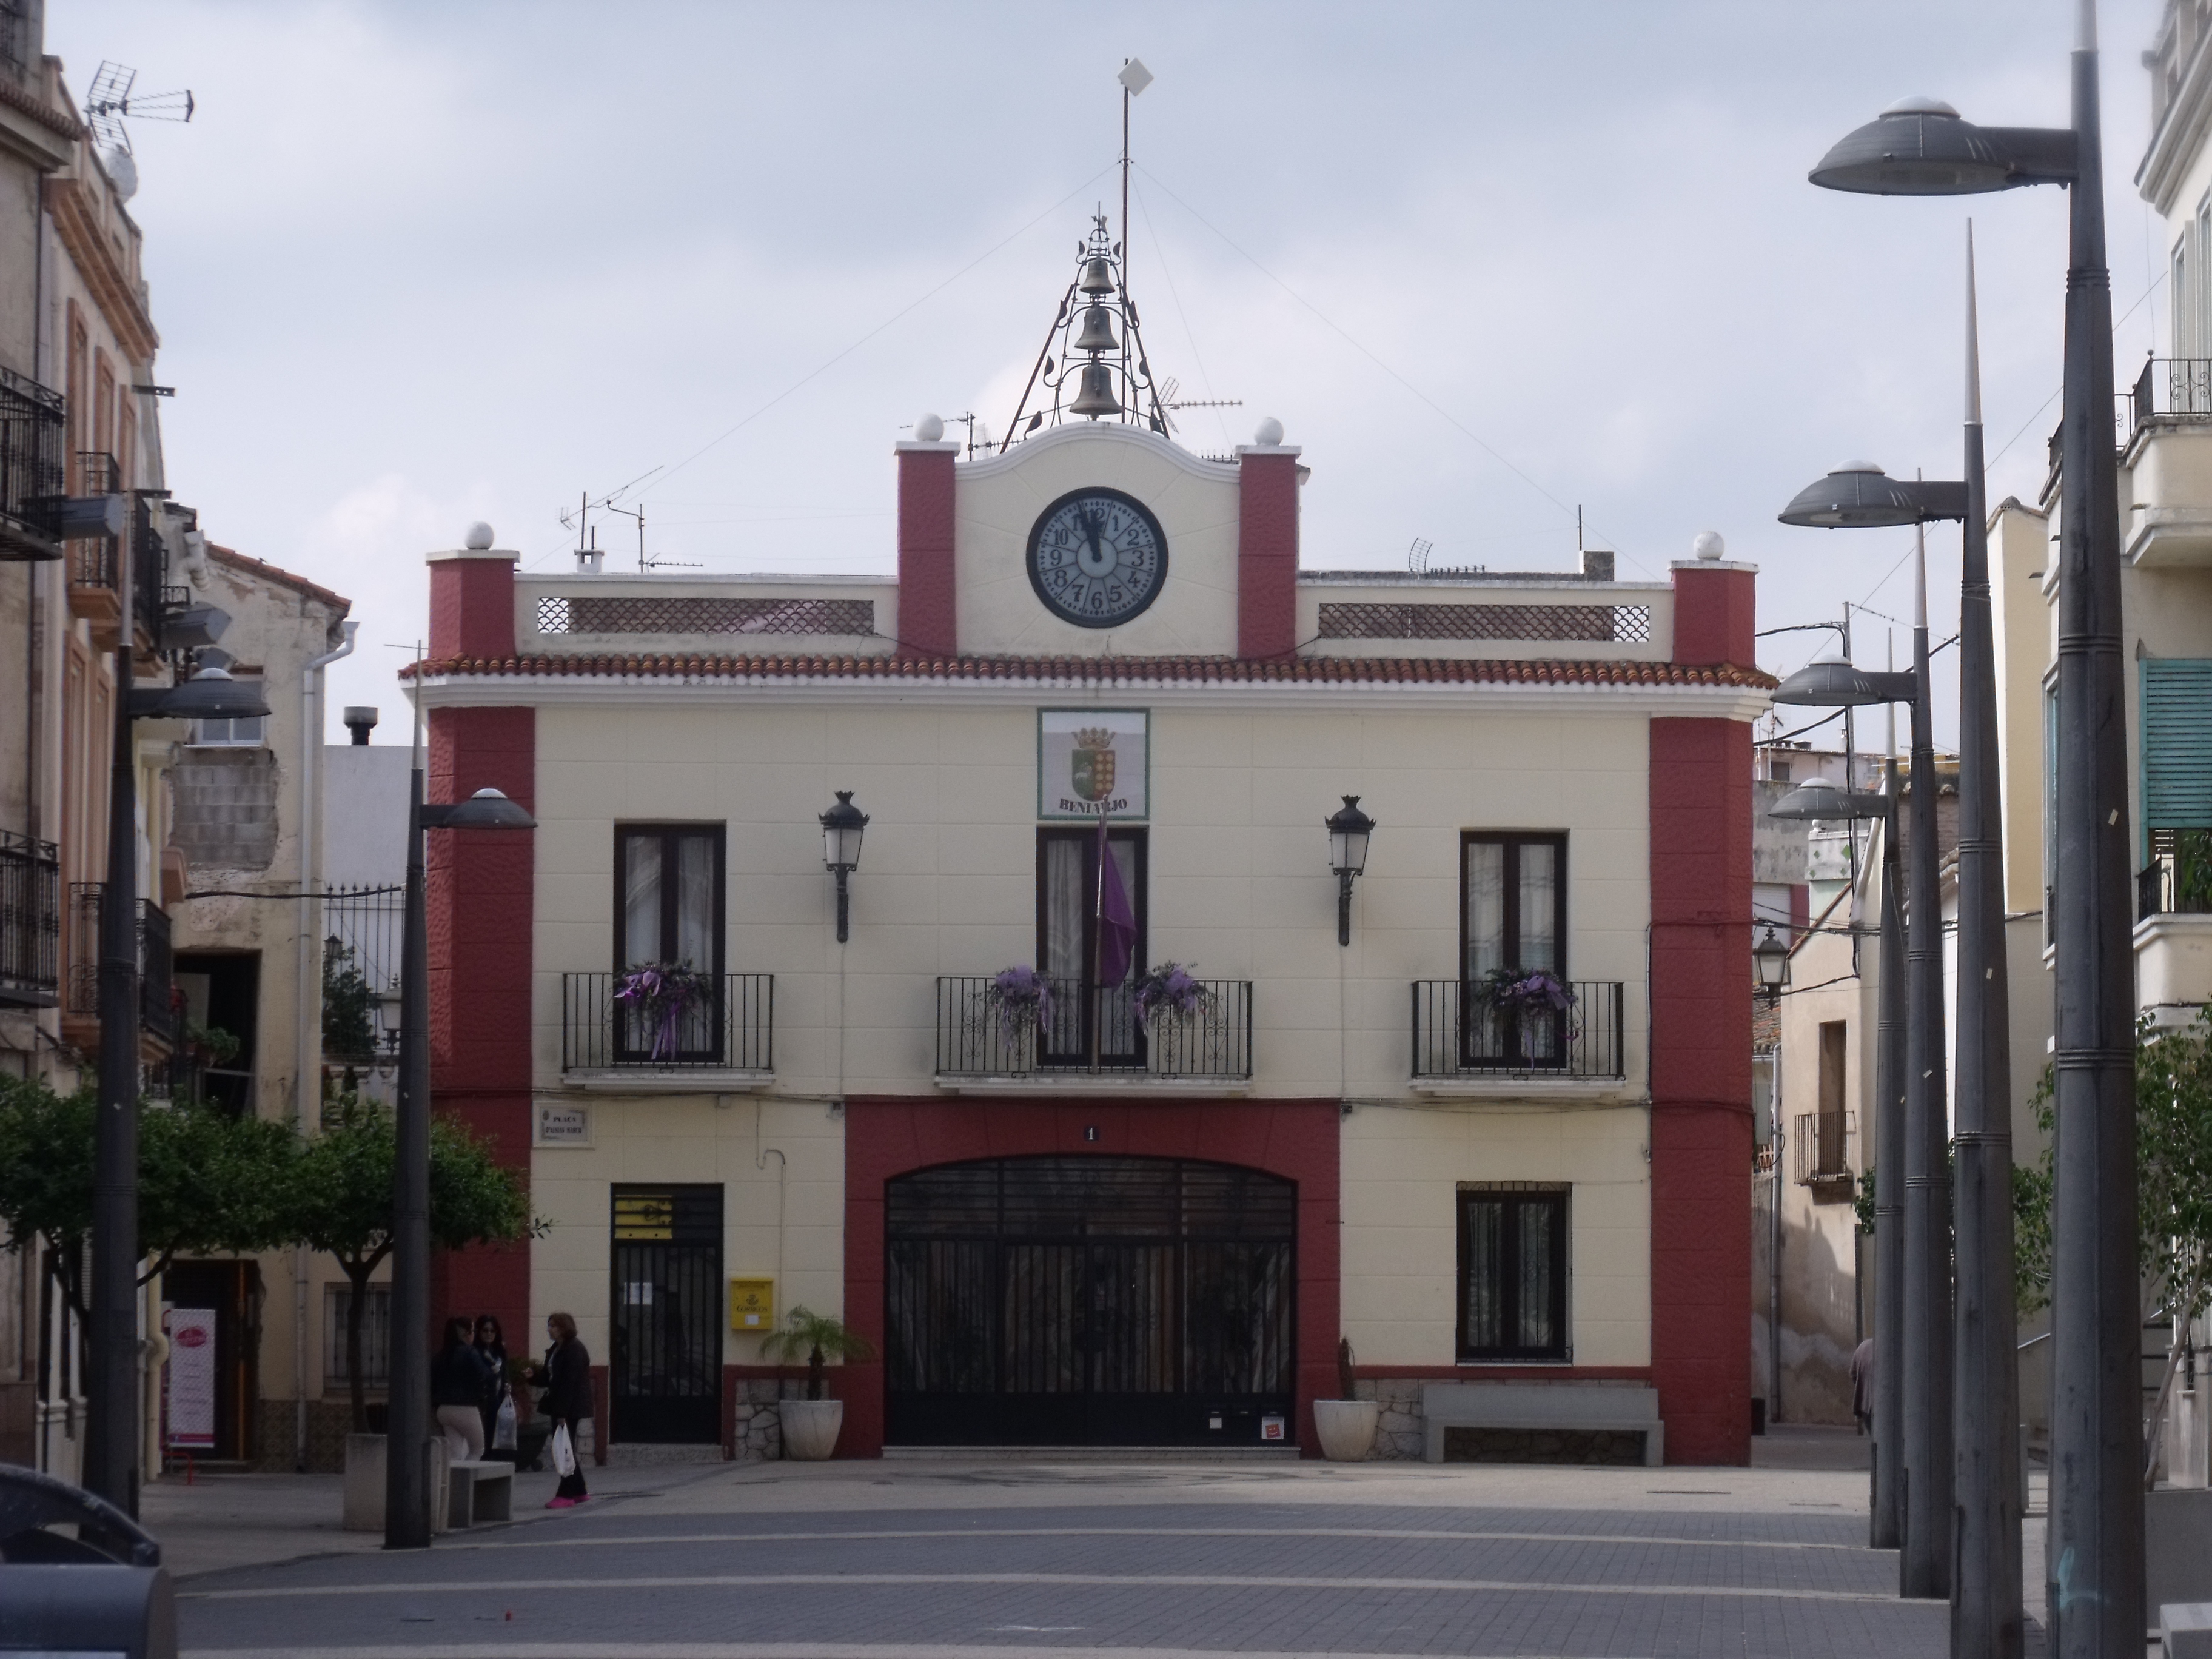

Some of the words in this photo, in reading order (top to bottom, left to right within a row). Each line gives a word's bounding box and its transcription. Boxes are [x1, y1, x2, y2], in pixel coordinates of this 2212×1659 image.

[1112, 515, 1119, 531] 1
[1053, 529, 1069, 545] 10
[1127, 529, 1139, 546] 2
[1050, 549, 1062, 566] 9
[1131, 550, 1144, 566] 3
[1054, 570, 1067, 587] 8
[1128, 571, 1141, 588] 4
[1071, 585, 1084, 602] 7
[1091, 592, 1103, 609] 6
[1110, 586, 1122, 602] 5
[1088, 1127, 1093, 1140] 1
